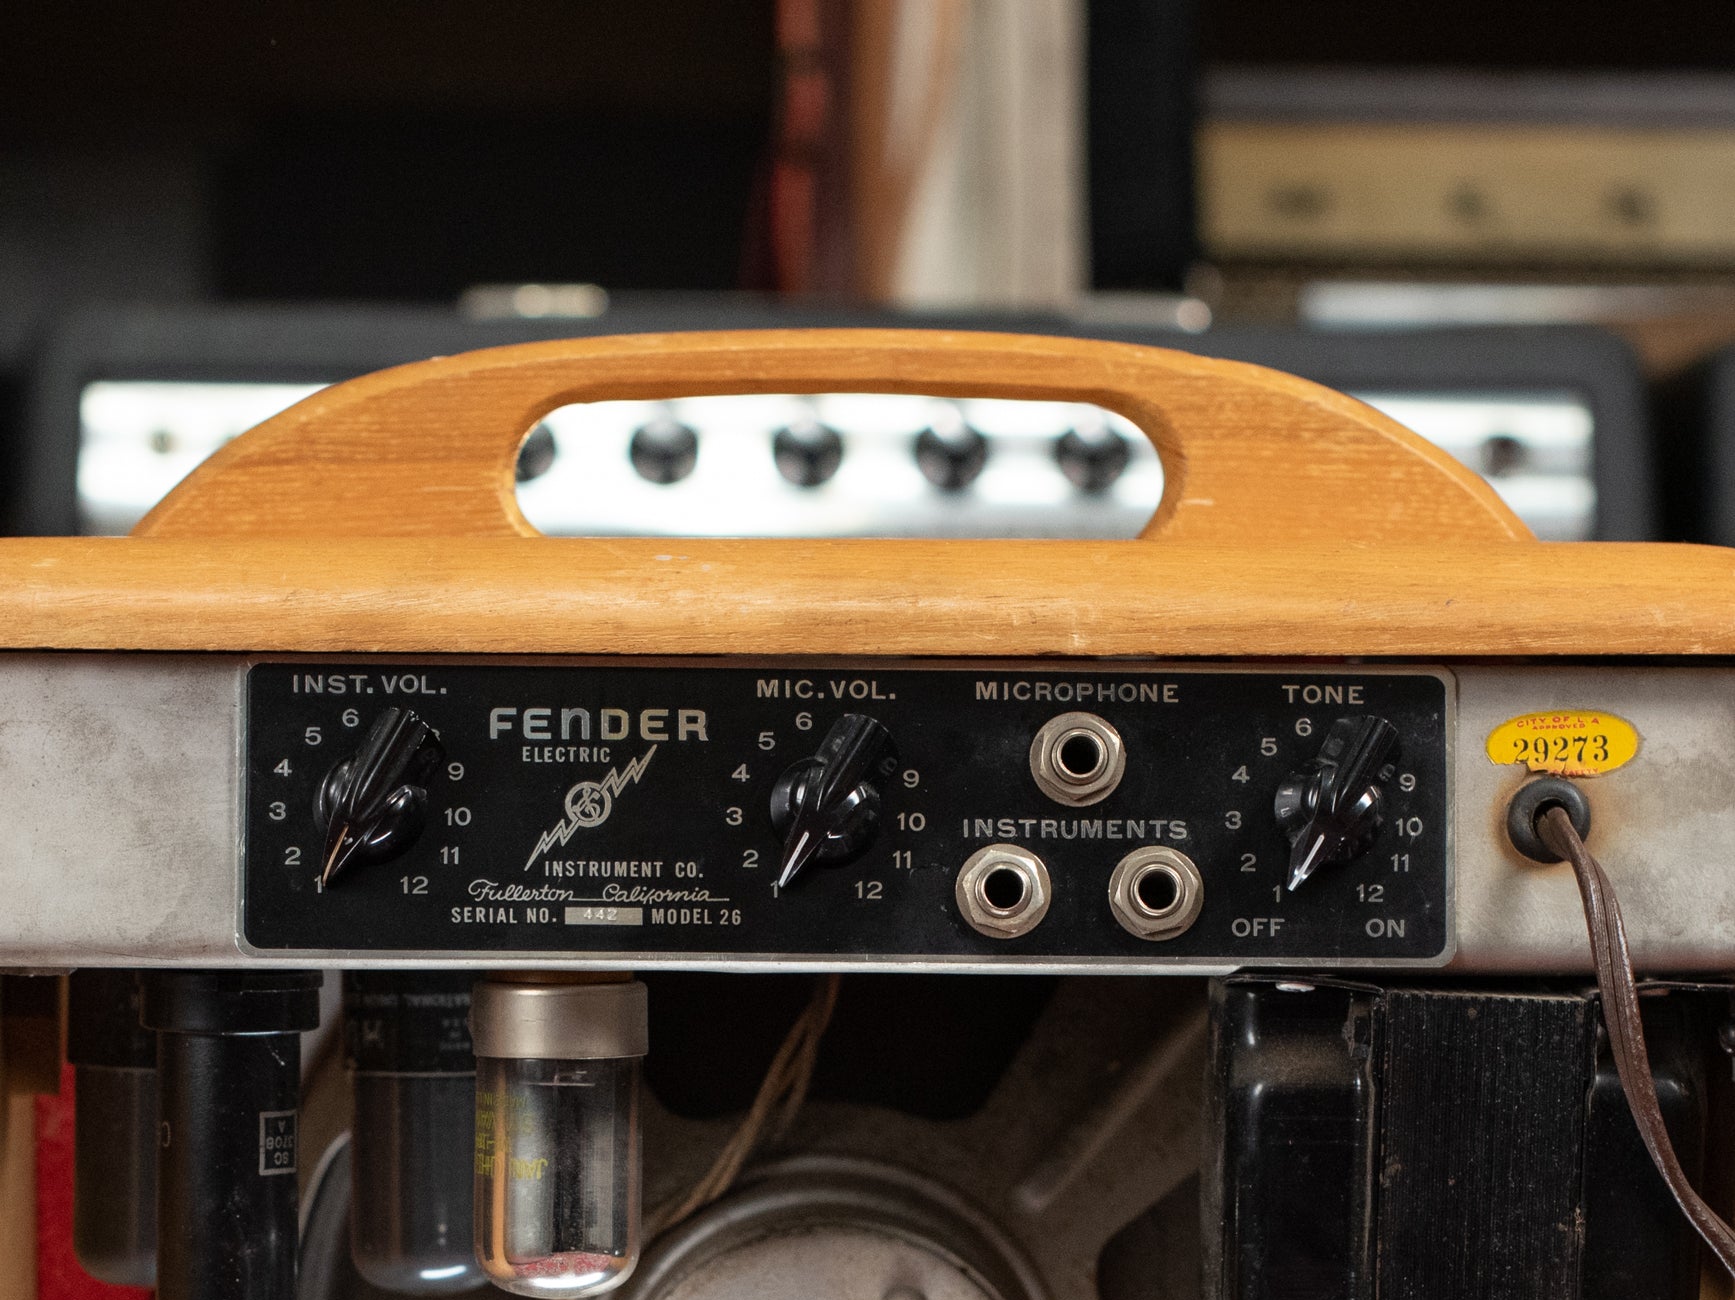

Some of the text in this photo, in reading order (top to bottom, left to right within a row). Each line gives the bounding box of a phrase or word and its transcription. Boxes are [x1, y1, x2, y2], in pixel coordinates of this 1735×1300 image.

[976, 681, 1179, 703] MICROPHONE
[1282, 685, 1364, 705] TONE
[342, 708, 360, 727] 6
[795, 712, 813, 730] 6
[1517, 717, 1546, 728] CITY
[305, 727, 322, 745] 5
[1295, 718, 1312, 736] 6
[758, 732, 776, 750] 5
[1260, 738, 1278, 756] 5
[1513, 734, 1609, 764] 29273
[522, 746, 611, 763] ELECTRIC
[274, 759, 292, 777] 4
[448, 762, 465, 781] 9
[731, 763, 750, 782] 4
[1231, 765, 1250, 783] 4
[903, 770, 920, 788] 9
[1399, 773, 1416, 792] 9
[269, 802, 286, 820] 3
[444, 807, 472, 826] 10
[726, 808, 743, 825] 3
[1225, 811, 1242, 829] 3
[897, 812, 926, 831] 10
[963, 818, 1188, 840] INSTRUMENTS
[1395, 817, 1423, 837] 10
[284, 846, 301, 865] 2
[440, 847, 460, 865] 11
[742, 850, 759, 868] 2
[892, 850, 912, 869] 11
[1240, 853, 1256, 872] 2
[1390, 854, 1410, 872] 11
[545, 861, 703, 878] INSTRUMENT CO.
[314, 875, 323, 894] 1
[400, 876, 429, 895] 12
[468, 879, 718, 904] Fullerton California
[770, 880, 778, 898] 1
[854, 881, 883, 899] 12
[1272, 884, 1281, 903] 1
[1356, 884, 1384, 902] 12
[451, 907, 741, 925] SERIAL NO. 442 MODEL 26
[1231, 918, 1285, 937] OFF
[1365, 919, 1405, 936] ON
